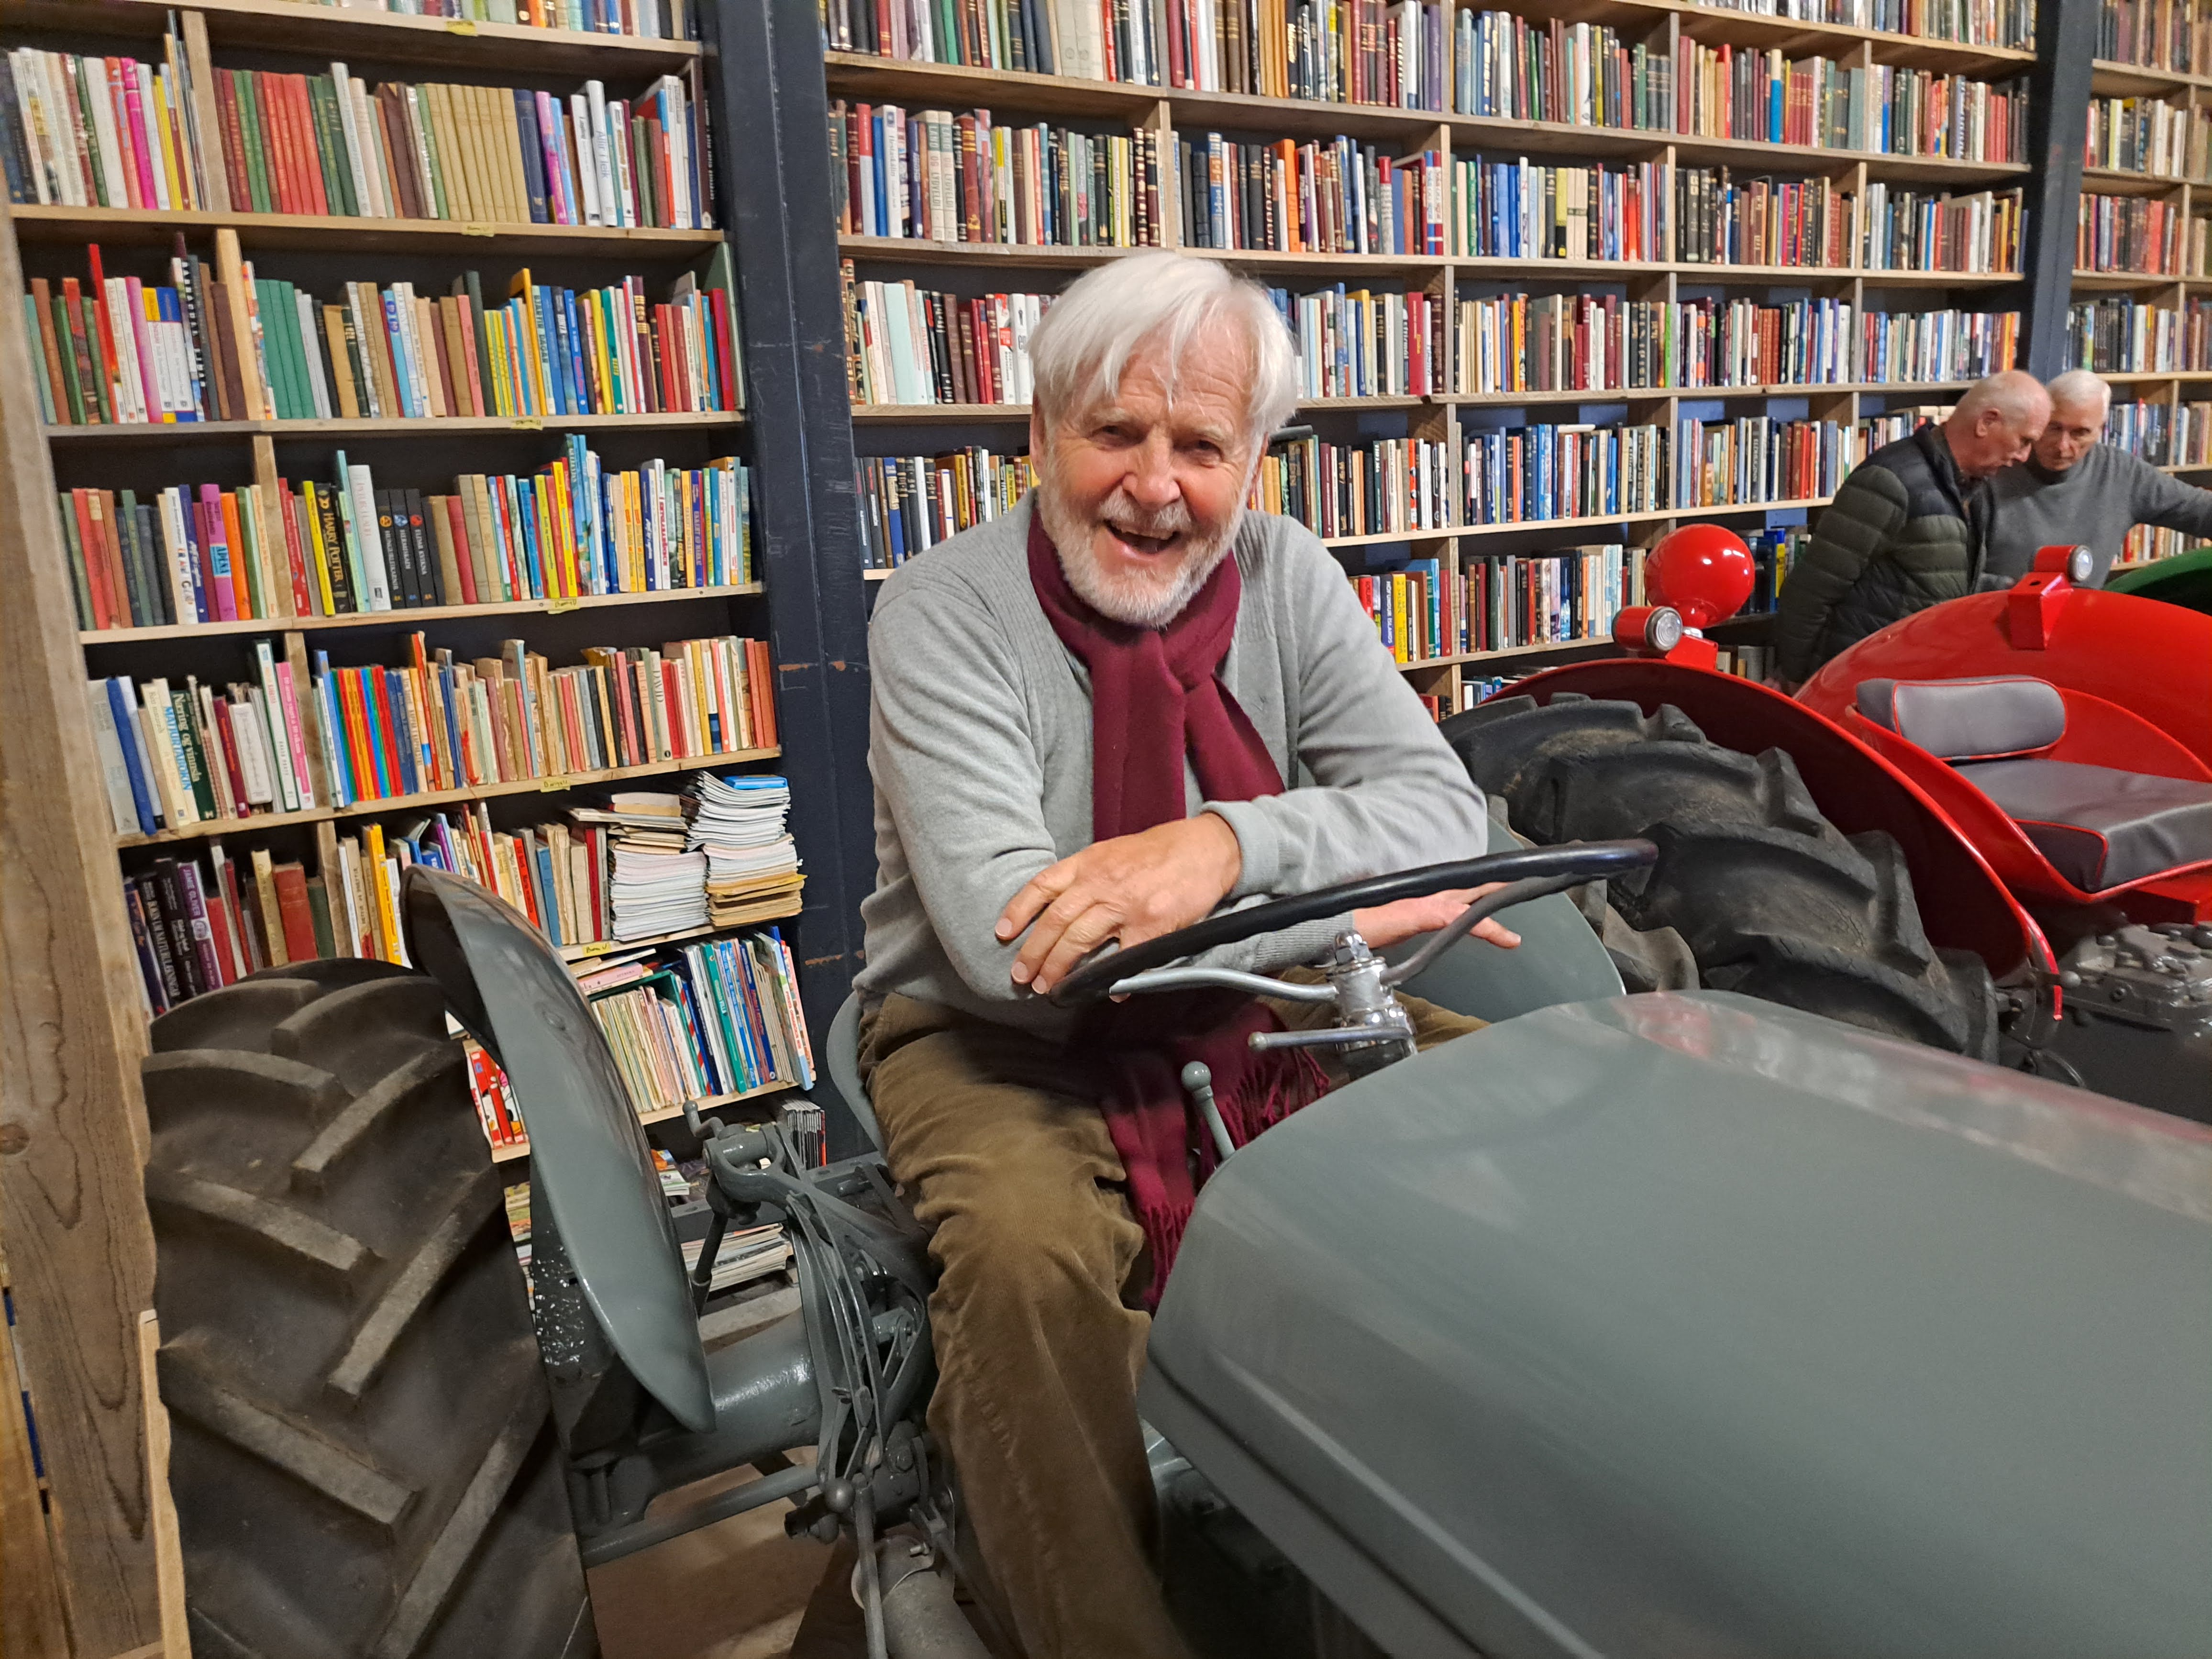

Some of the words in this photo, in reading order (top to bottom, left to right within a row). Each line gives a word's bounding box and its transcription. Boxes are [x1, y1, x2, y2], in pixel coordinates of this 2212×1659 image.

[323, 513, 338, 544] HARRY
[330, 546, 344, 582] POTTER
[419, 551, 427, 575] KVIKNA
[653, 670, 664, 703] DAVID
[173, 693, 189, 730] Næring
[182, 733, 192, 746] og
[186, 747, 201, 782] vinnsla
[183, 869, 194, 889] JAMIE
[189, 891, 200, 917] OLIVER
